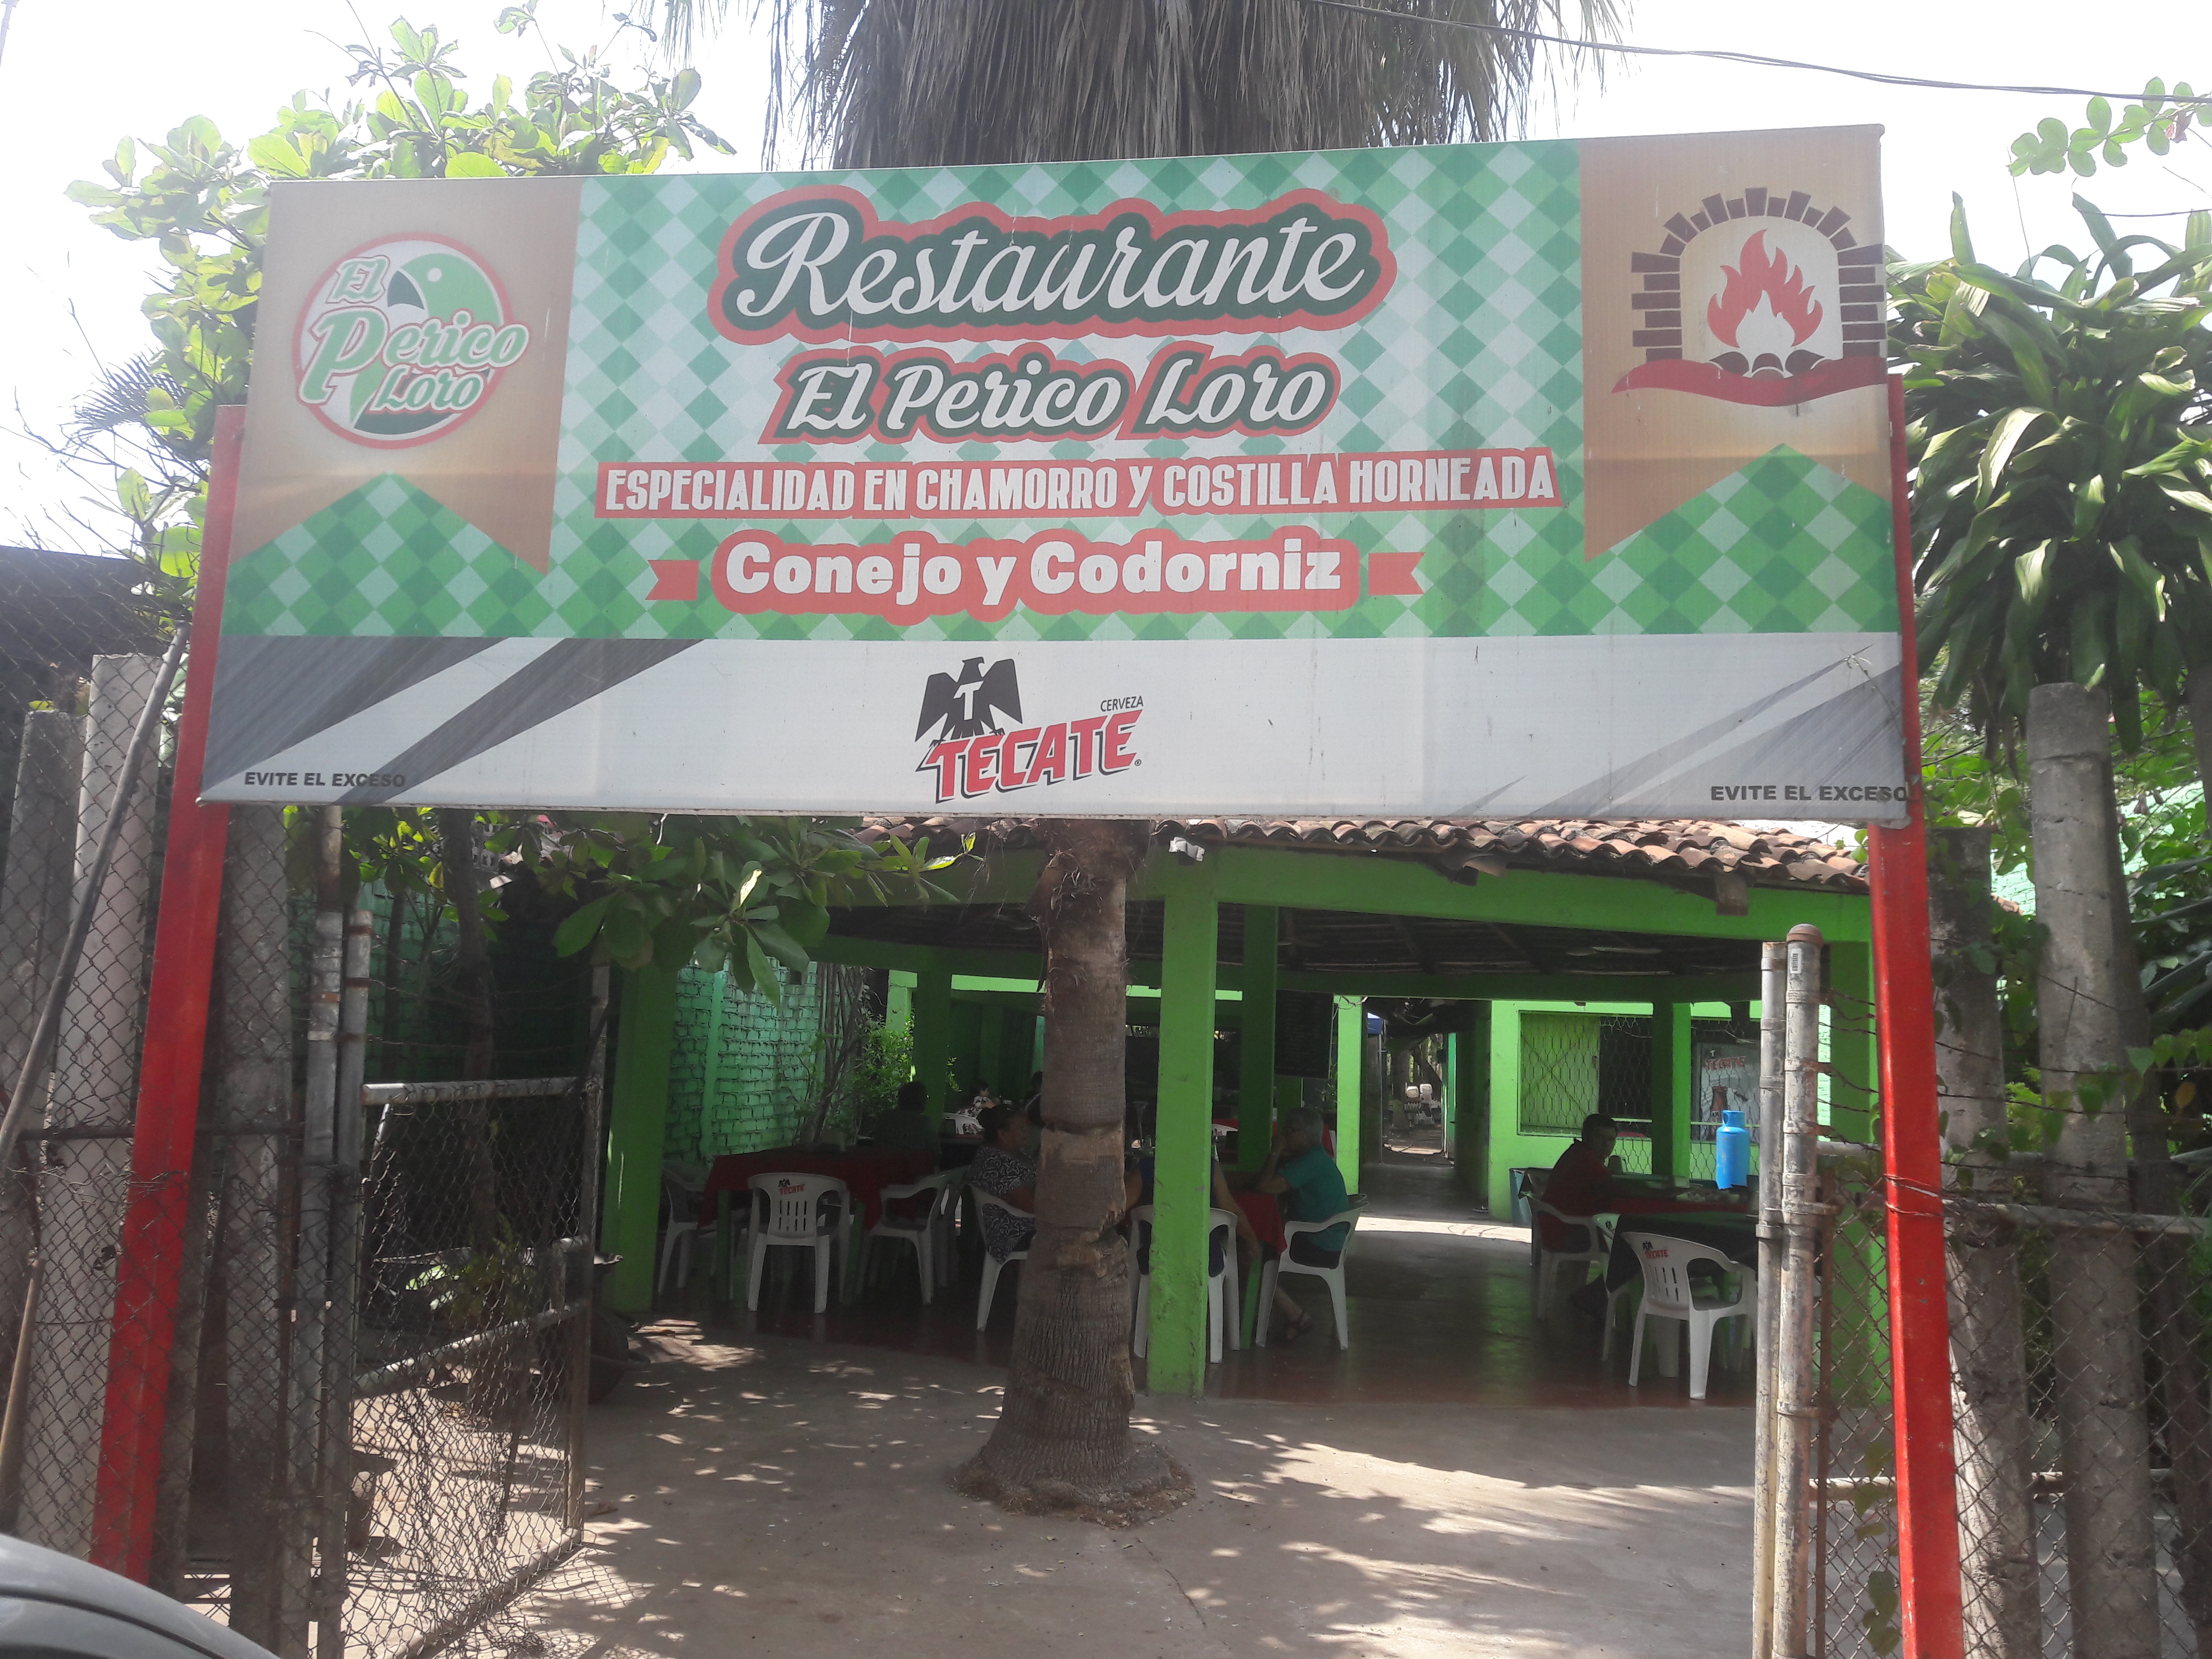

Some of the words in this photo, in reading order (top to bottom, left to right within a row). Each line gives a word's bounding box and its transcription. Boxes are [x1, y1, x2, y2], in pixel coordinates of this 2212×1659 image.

[328, 256, 389, 303] El
[736, 212, 1365, 316] Restaurante
[300, 307, 529, 403] Perico
[370, 365, 484, 412] Loro
[786, 362, 873, 430] El
[886, 358, 1122, 430] Perico
[1145, 357, 1326, 424] Loro
[605, 469, 856, 511] ESPECIALIDAD
[863, 469, 908, 511] EN
[915, 466, 1118, 511] CHAMORRO
[1163, 461, 1339, 507] COSTILLA
[1349, 455, 1556, 504] HORNEADA
[726, 541, 962, 606] Conejo
[975, 556, 1018, 606] y
[1030, 537, 1341, 595] Codorniz
[953, 681, 985, 721] T
[1100, 695, 1144, 712] CERVEZA
[244, 772, 298, 786] EVITE
[304, 773, 325, 787] EL
[331, 773, 406, 788] EXCESO
[915, 709, 1142, 804] TECATE
[1710, 785, 1777, 801] EVITE
[1784, 786, 1812, 801] EL
[1819, 786, 1908, 802] EXCESO
